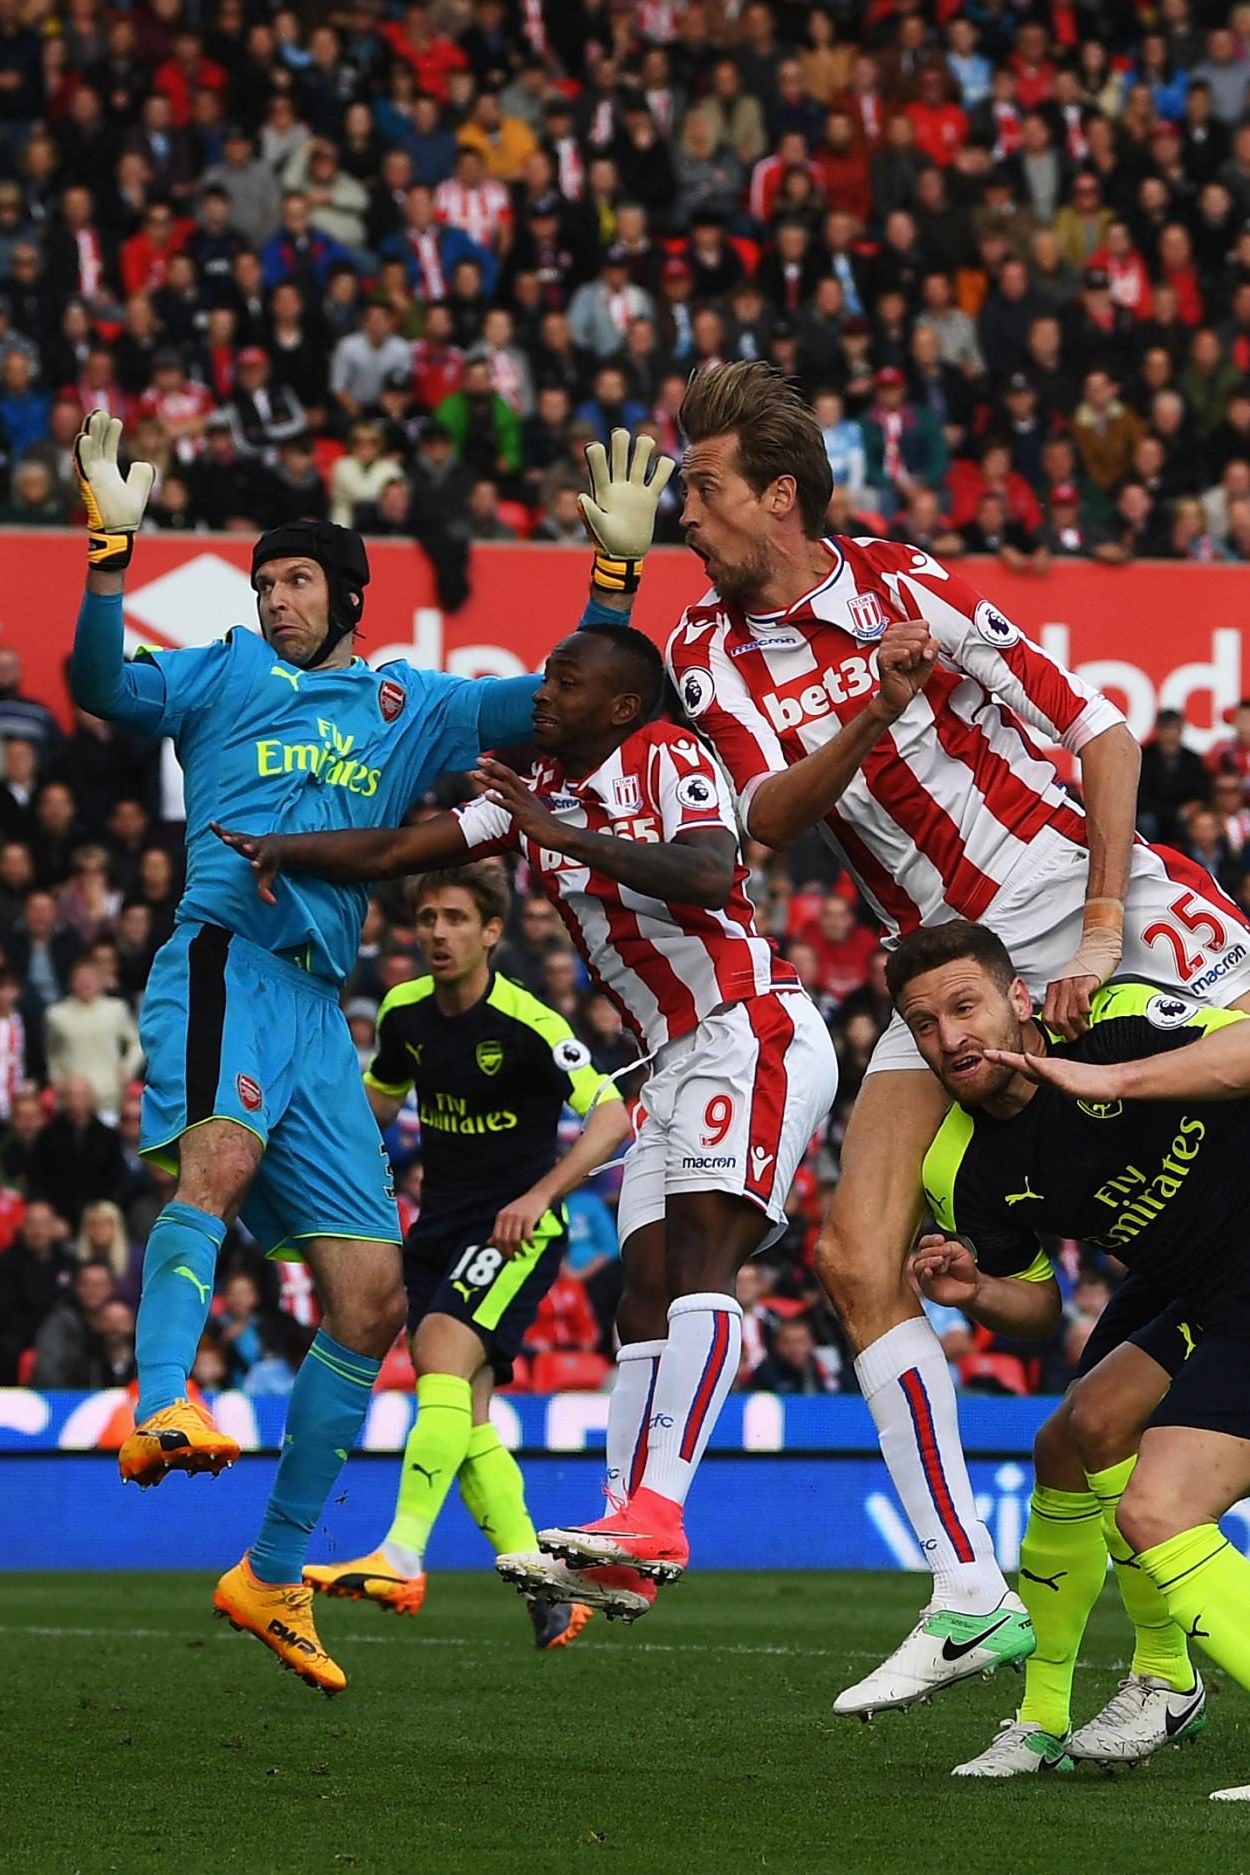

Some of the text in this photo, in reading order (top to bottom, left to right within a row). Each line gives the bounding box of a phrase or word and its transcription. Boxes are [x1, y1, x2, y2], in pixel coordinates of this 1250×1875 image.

[762, 648, 880, 733] bet3
[317, 717, 354, 755] Fly
[256, 740, 382, 797] Emirates
[1141, 890, 1227, 983] 25
[1190, 944, 1247, 995] macron
[701, 1093, 733, 1148] 9
[682, 1157, 736, 1169] macron
[1093, 1165, 1147, 1208] Fly
[449, 1245, 502, 1286] 18
